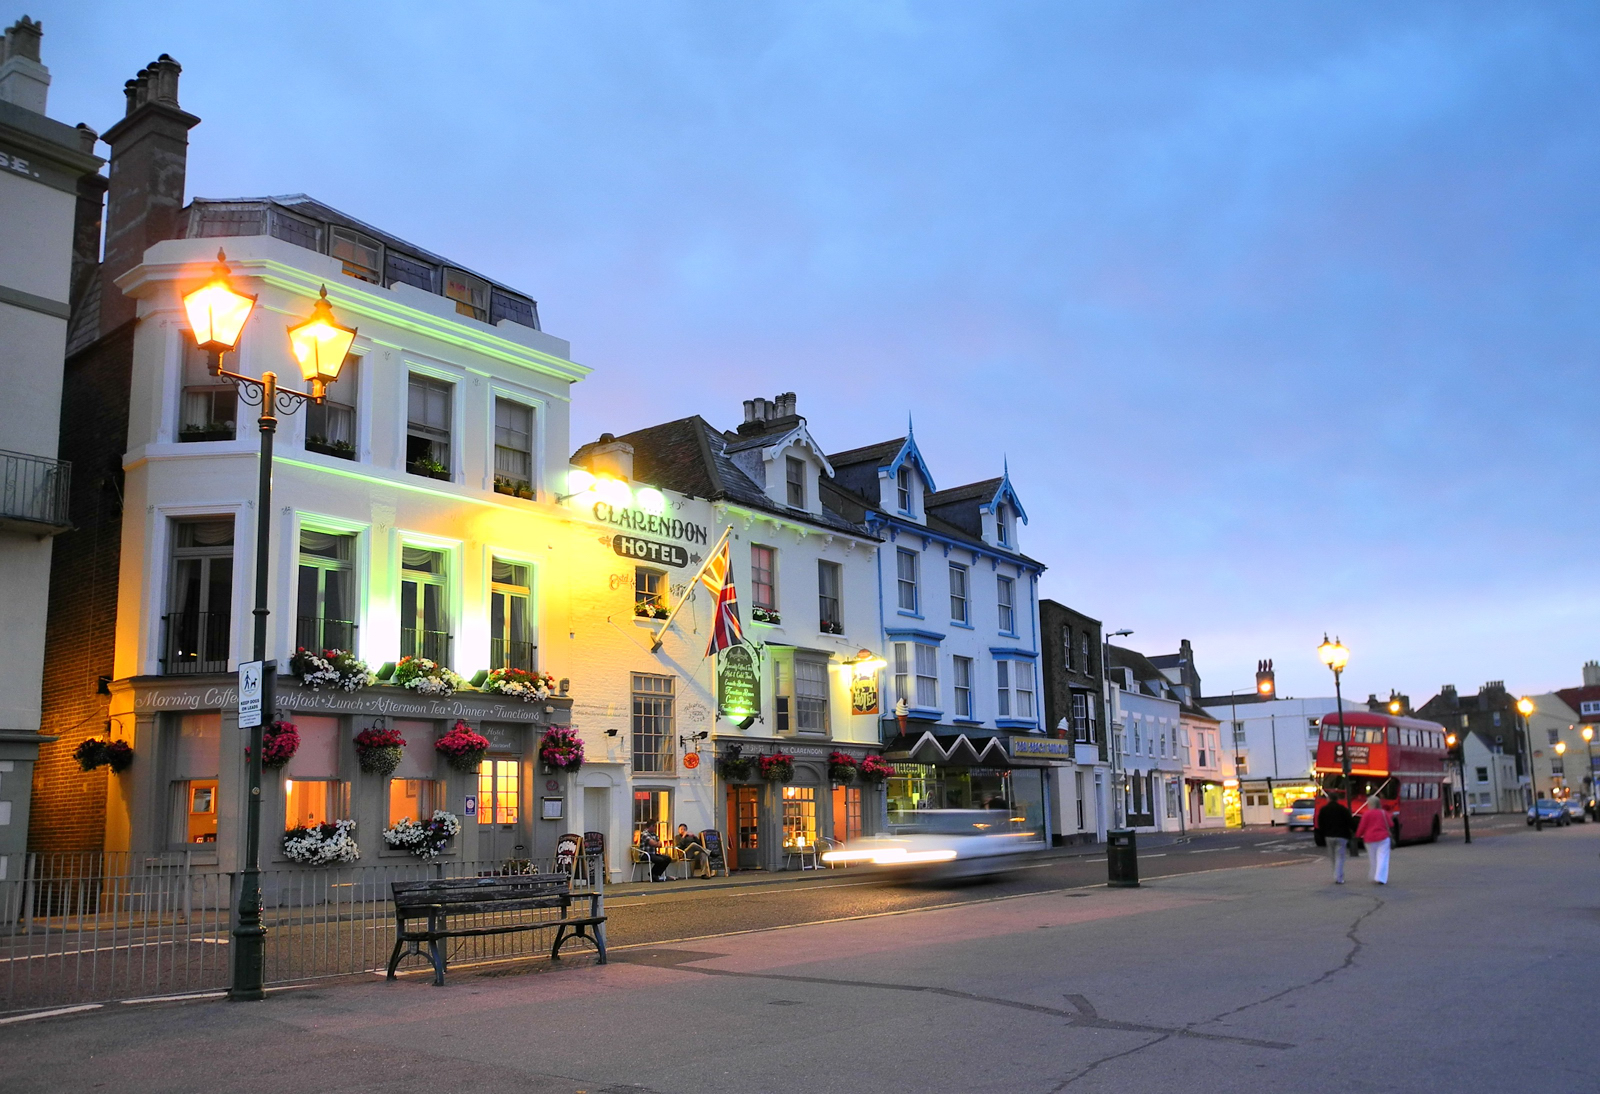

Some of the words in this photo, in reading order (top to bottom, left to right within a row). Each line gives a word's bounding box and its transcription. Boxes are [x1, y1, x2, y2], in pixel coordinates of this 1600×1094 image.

[592, 501, 708, 545] CLARENDON
[621, 537, 683, 564] HOTEL
[135, 691, 201, 710] Morning
[325, 694, 364, 710] Lunch
[371, 697, 427, 713] Afternoon
[429, 700, 446, 715] Tea
[452, 702, 489, 716] Dinner
[494, 704, 540, 720] Functions
[486, 727, 504, 735] Hotel
[790, 747, 823, 755] CLARENDON
